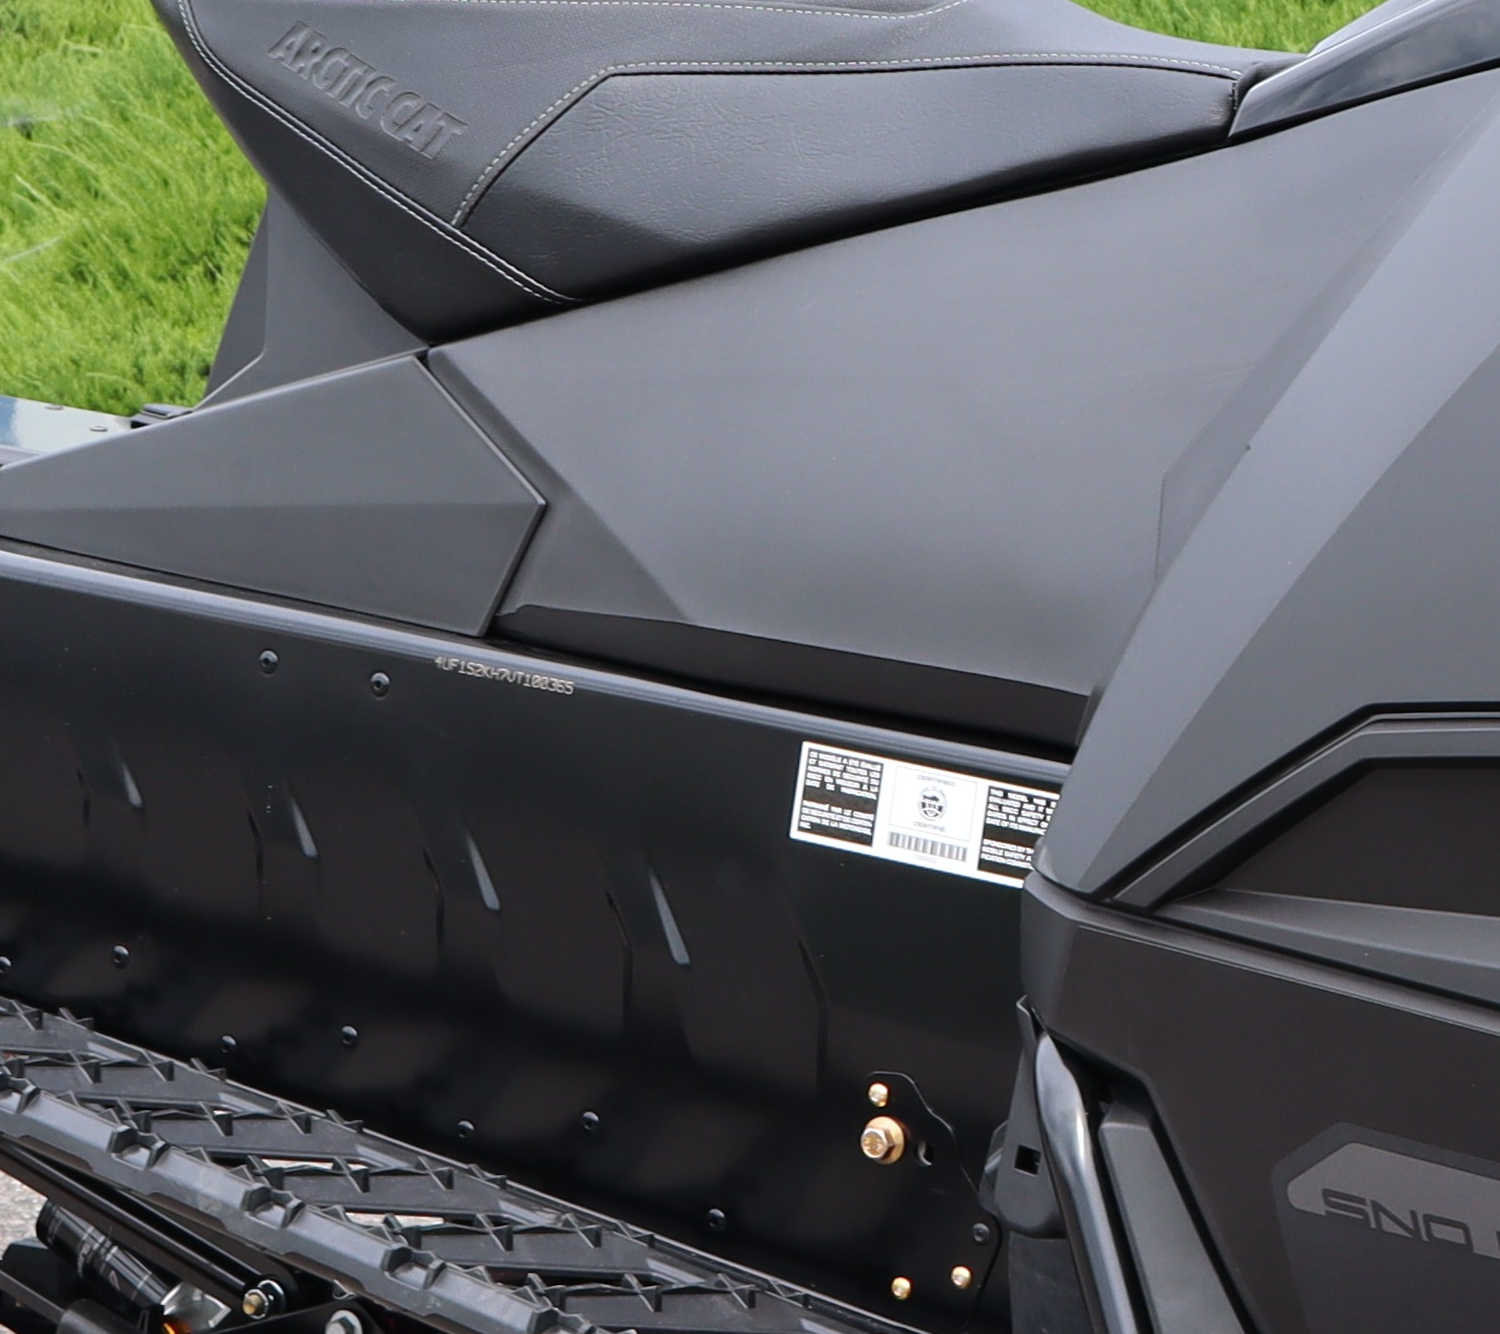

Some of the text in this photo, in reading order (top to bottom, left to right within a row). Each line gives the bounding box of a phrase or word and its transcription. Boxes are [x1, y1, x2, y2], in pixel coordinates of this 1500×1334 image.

[267, 20, 468, 160] ARCTIC CAT
[1321, 1187, 1474, 1254] SNO
